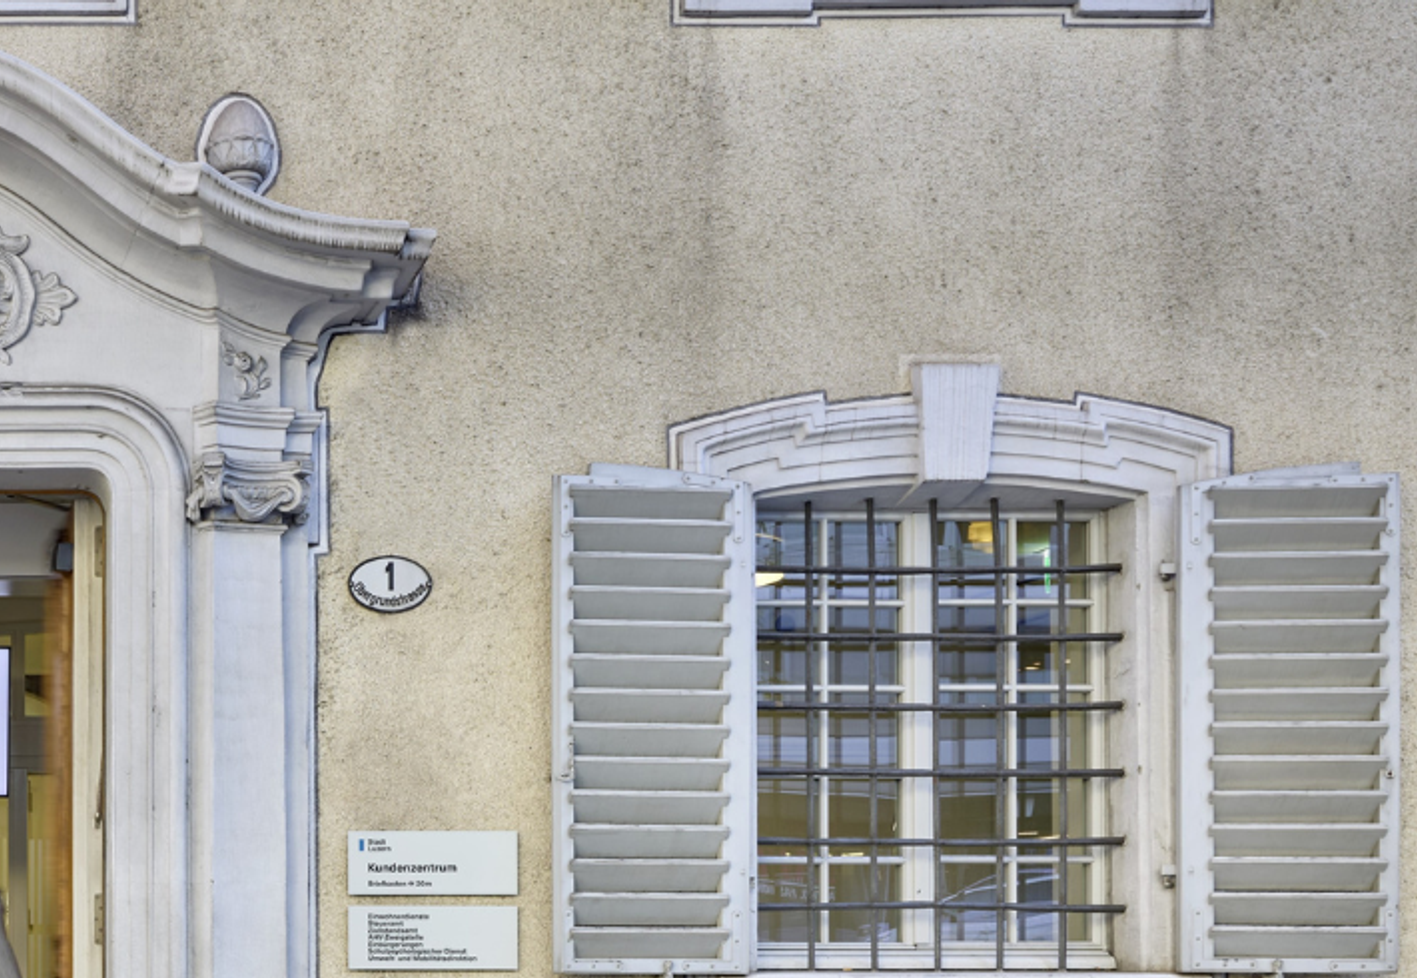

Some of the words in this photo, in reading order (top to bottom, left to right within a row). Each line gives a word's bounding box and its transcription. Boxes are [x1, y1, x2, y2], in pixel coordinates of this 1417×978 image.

[385, 561, 395, 591] 1
[354, 580, 427, 607] Obergrundstrasse
[367, 838, 387, 846] Stadt
[367, 862, 458, 873] Kundenzentrum
